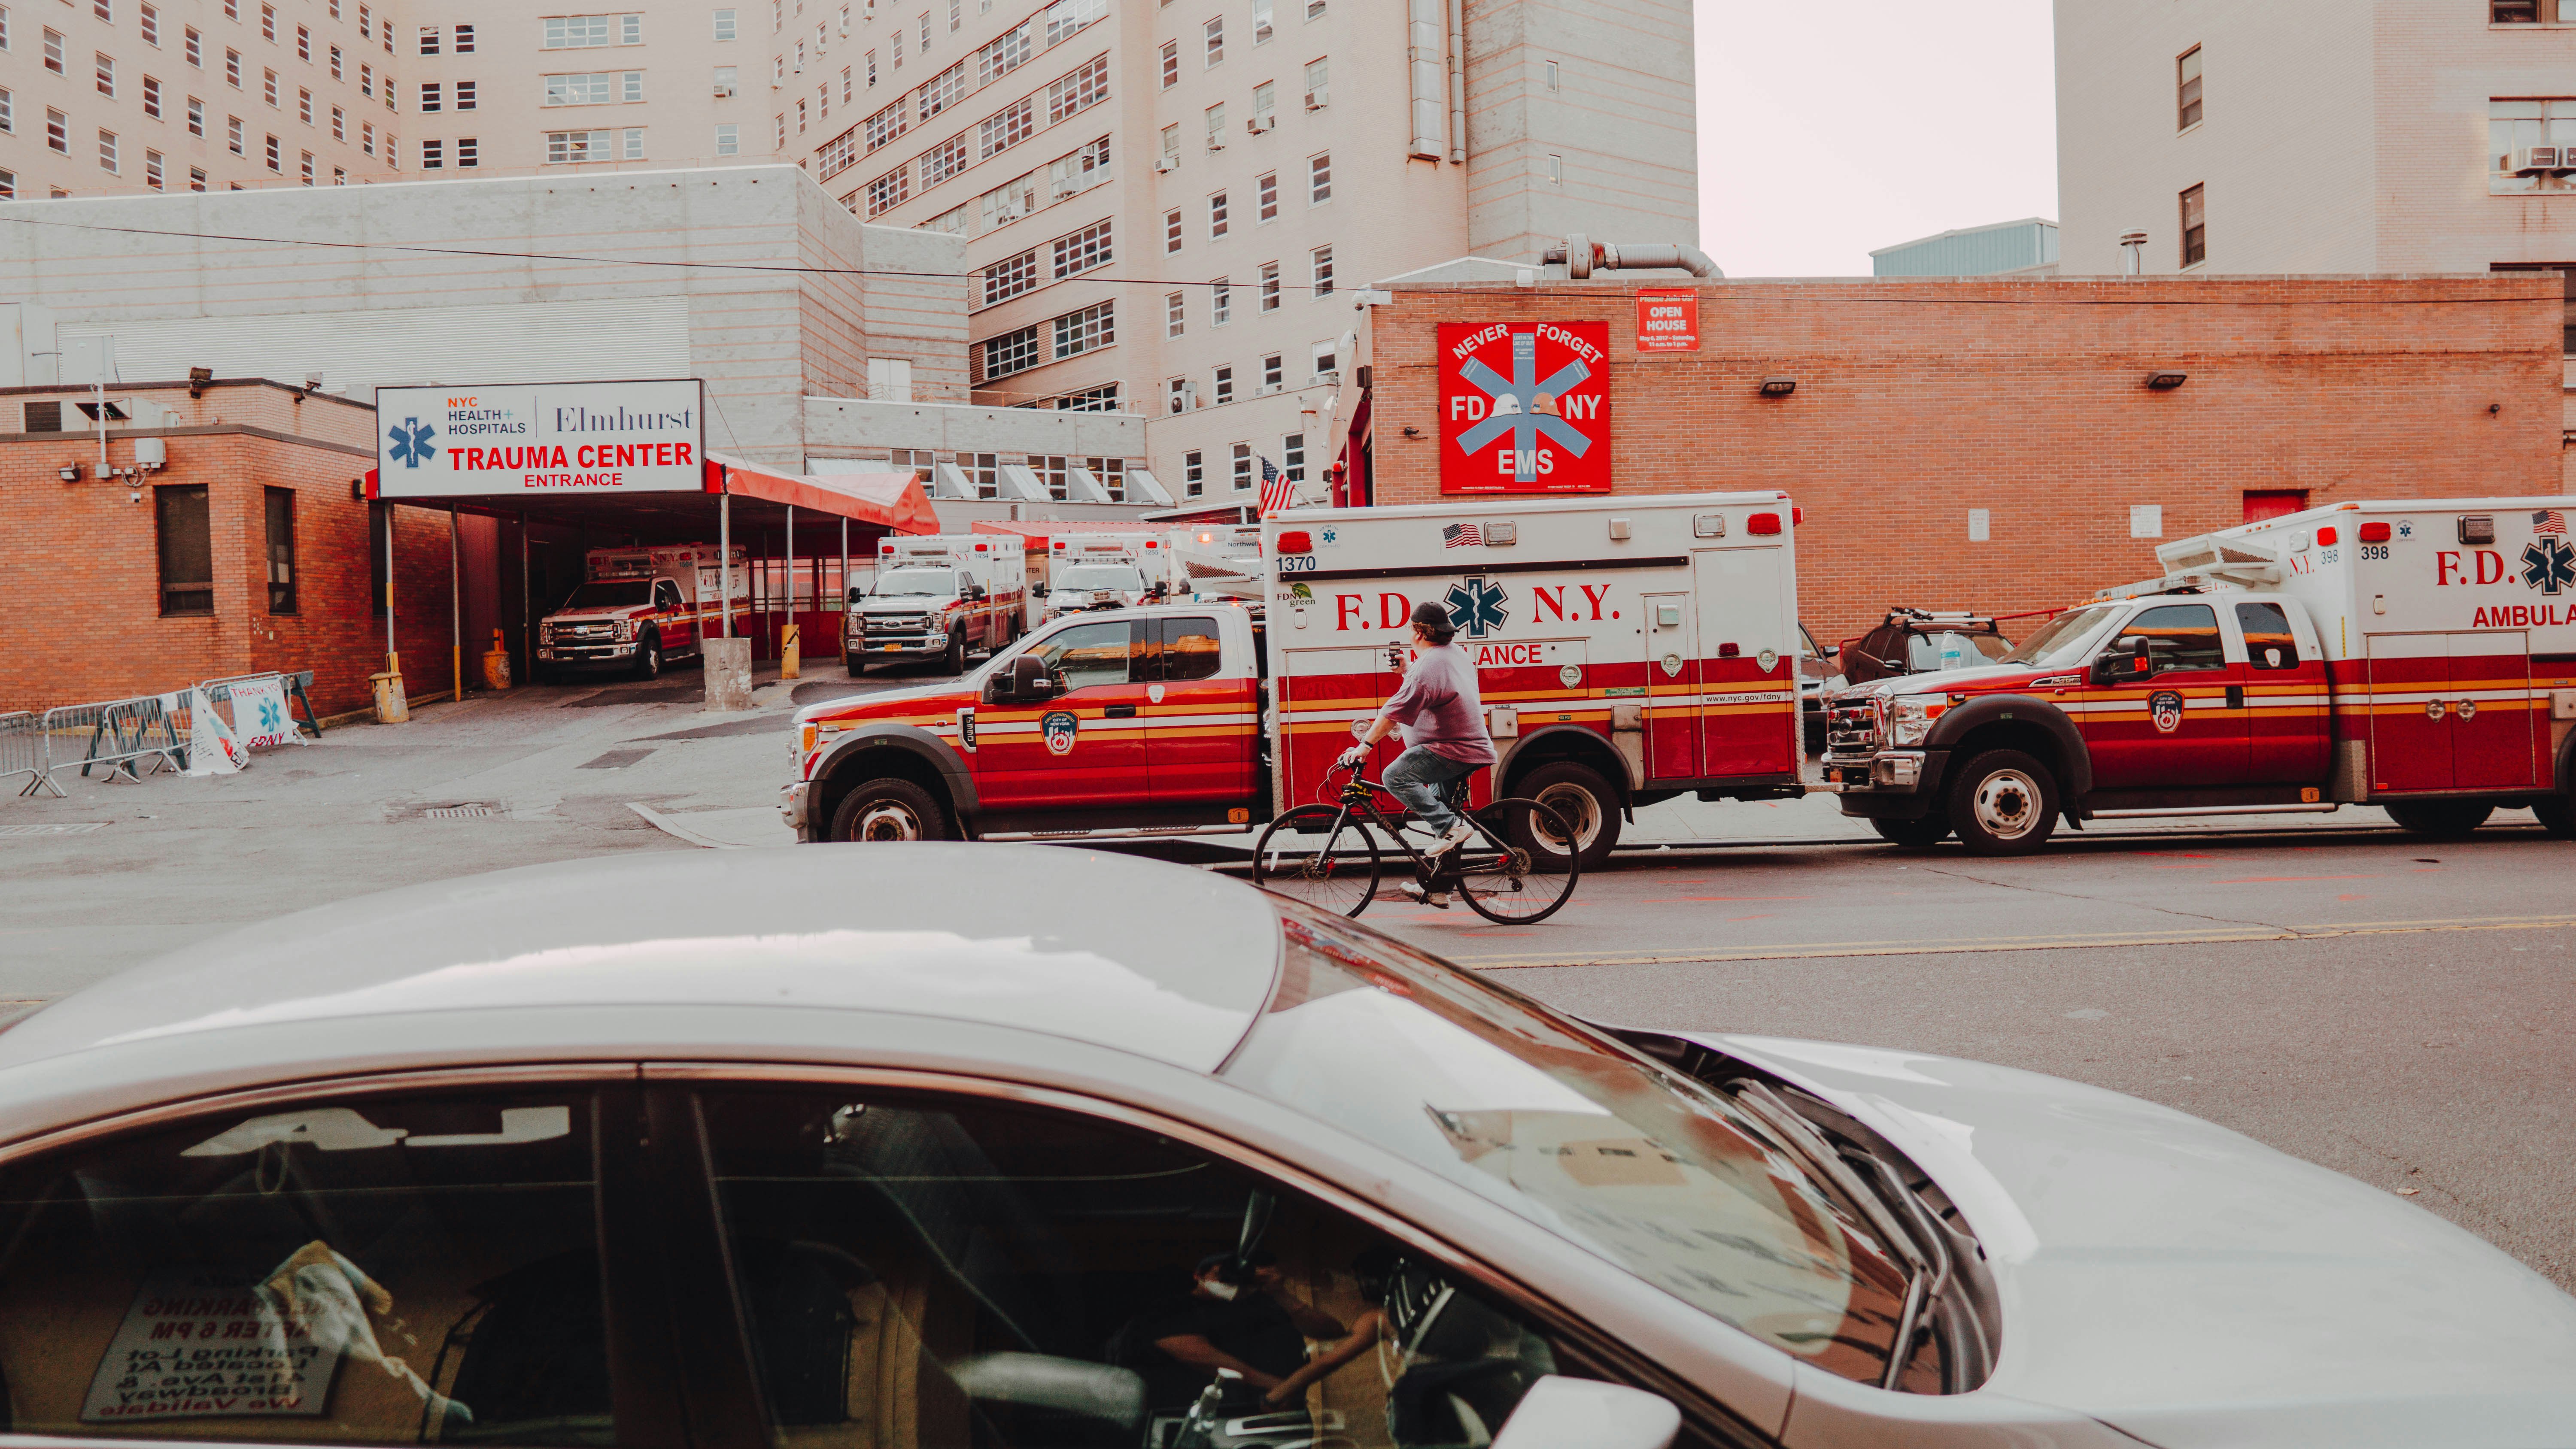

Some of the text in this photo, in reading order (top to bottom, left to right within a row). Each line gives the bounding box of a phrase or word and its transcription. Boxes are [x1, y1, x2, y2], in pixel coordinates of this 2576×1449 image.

[1650, 306, 1682, 317] OPEN
[1646, 320, 1686, 330] HOUSE
[1452, 323, 1604, 364] NEVER FORGET
[448, 397, 478, 407] NYC
[1451, 394, 1601, 421] FD NY
[553, 406, 694, 433] Elmhurst
[448, 423, 526, 435] HOSPITALS
[448, 443, 694, 471] TRAUMA CENTER
[1498, 449, 1554, 474] EMS
[524, 473, 623, 488] ENTRANCE
[2361, 546, 2389, 560] 398
[1276, 556, 1316, 571] 1370
[2290, 549, 2338, 577] N.Y. 398
[2436, 550, 2515, 586] F.D.
[1290, 599, 1315, 607] green
[1335, 584, 1620, 631] F.D N.Y.
[231, 687, 267, 697] THANK
[1706, 693, 1781, 702] www.nyc.gov/fdny
[1051, 712, 1075, 722] DEPARTMENT
[247, 732, 285, 747] FDNY
